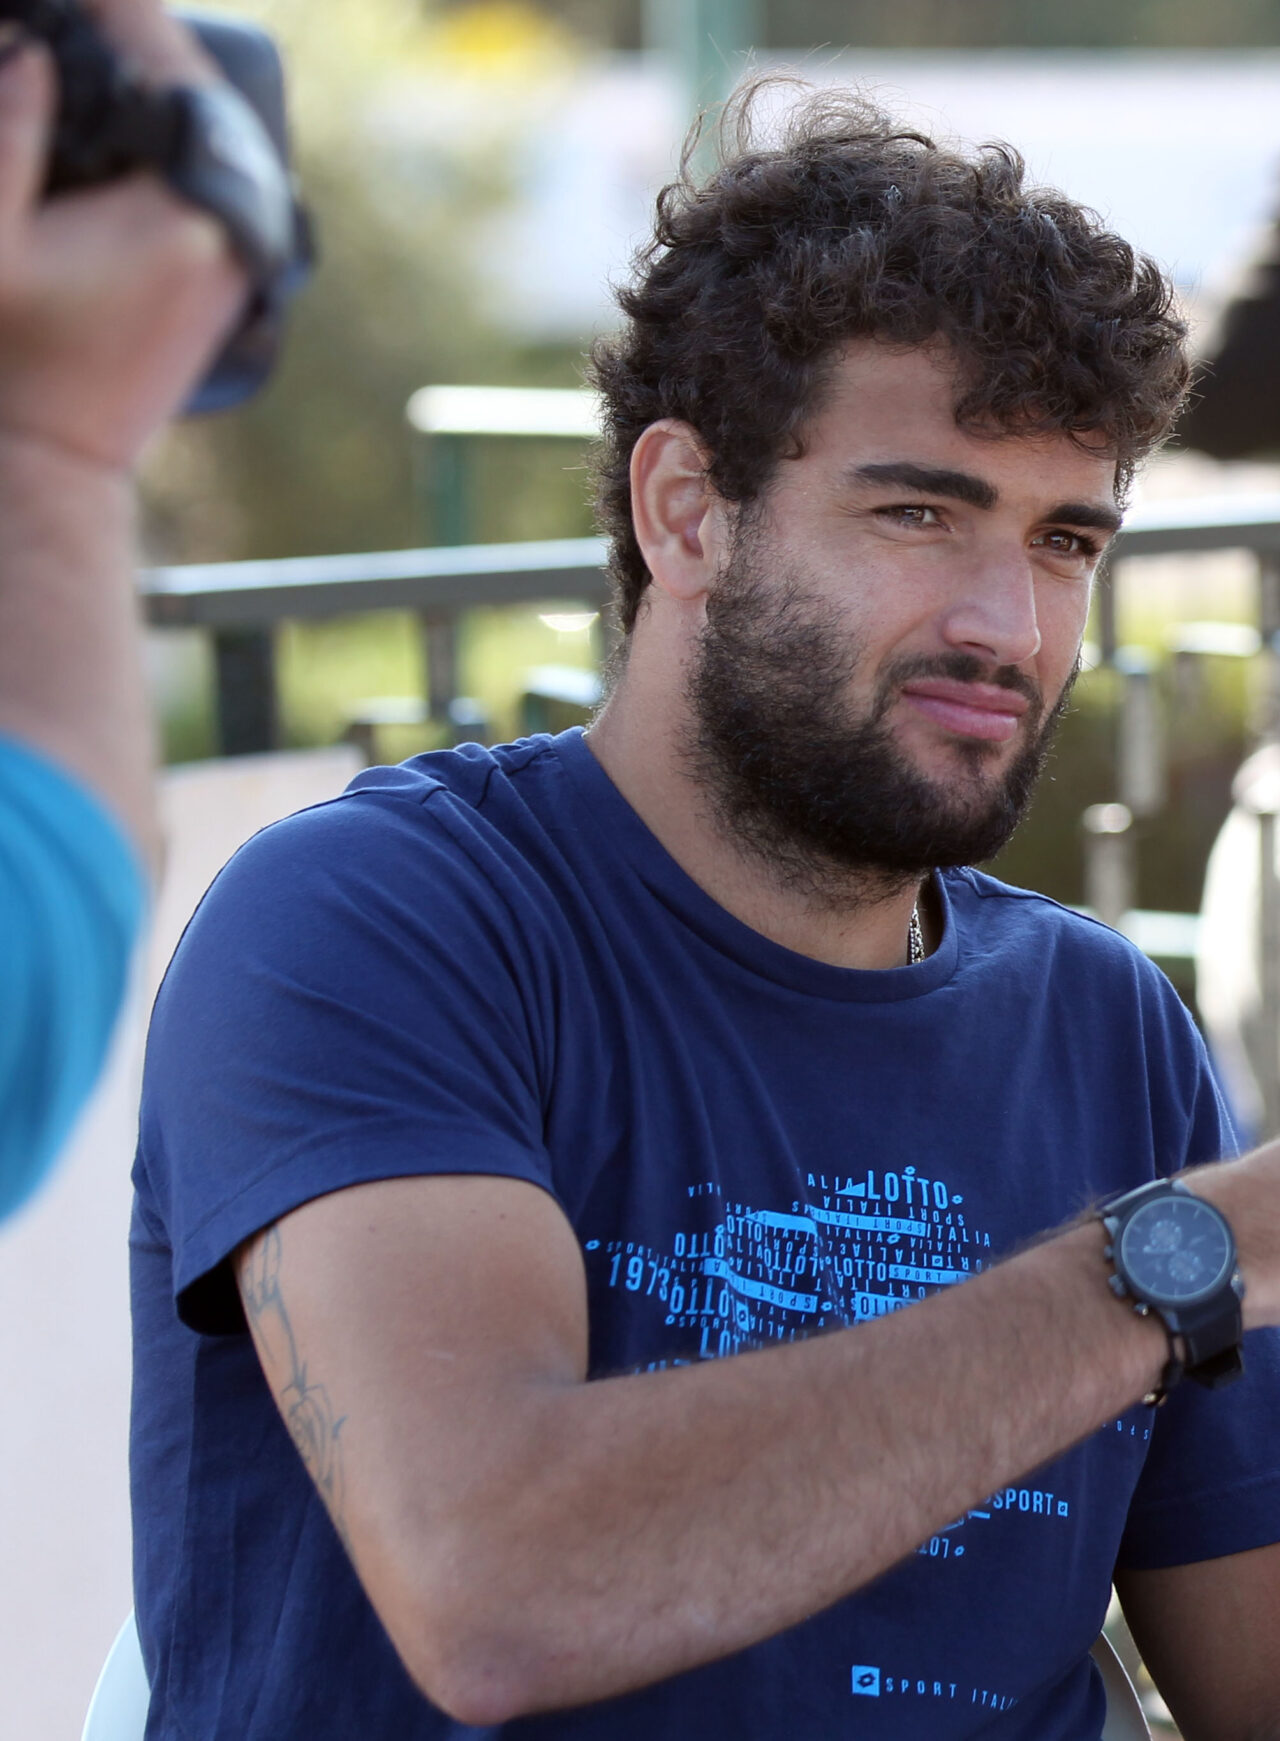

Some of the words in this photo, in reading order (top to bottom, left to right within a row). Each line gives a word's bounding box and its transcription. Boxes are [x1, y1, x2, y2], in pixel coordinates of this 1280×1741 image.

[866, 1169, 949, 1210] LOTTO
[926, 1222, 991, 1248] ITALIA
[609, 1252, 671, 1302] 1973
[834, 1254, 887, 1282] LOTTO
[992, 1487, 1054, 1516] SPORT
[885, 1676, 957, 1699] SPORT
